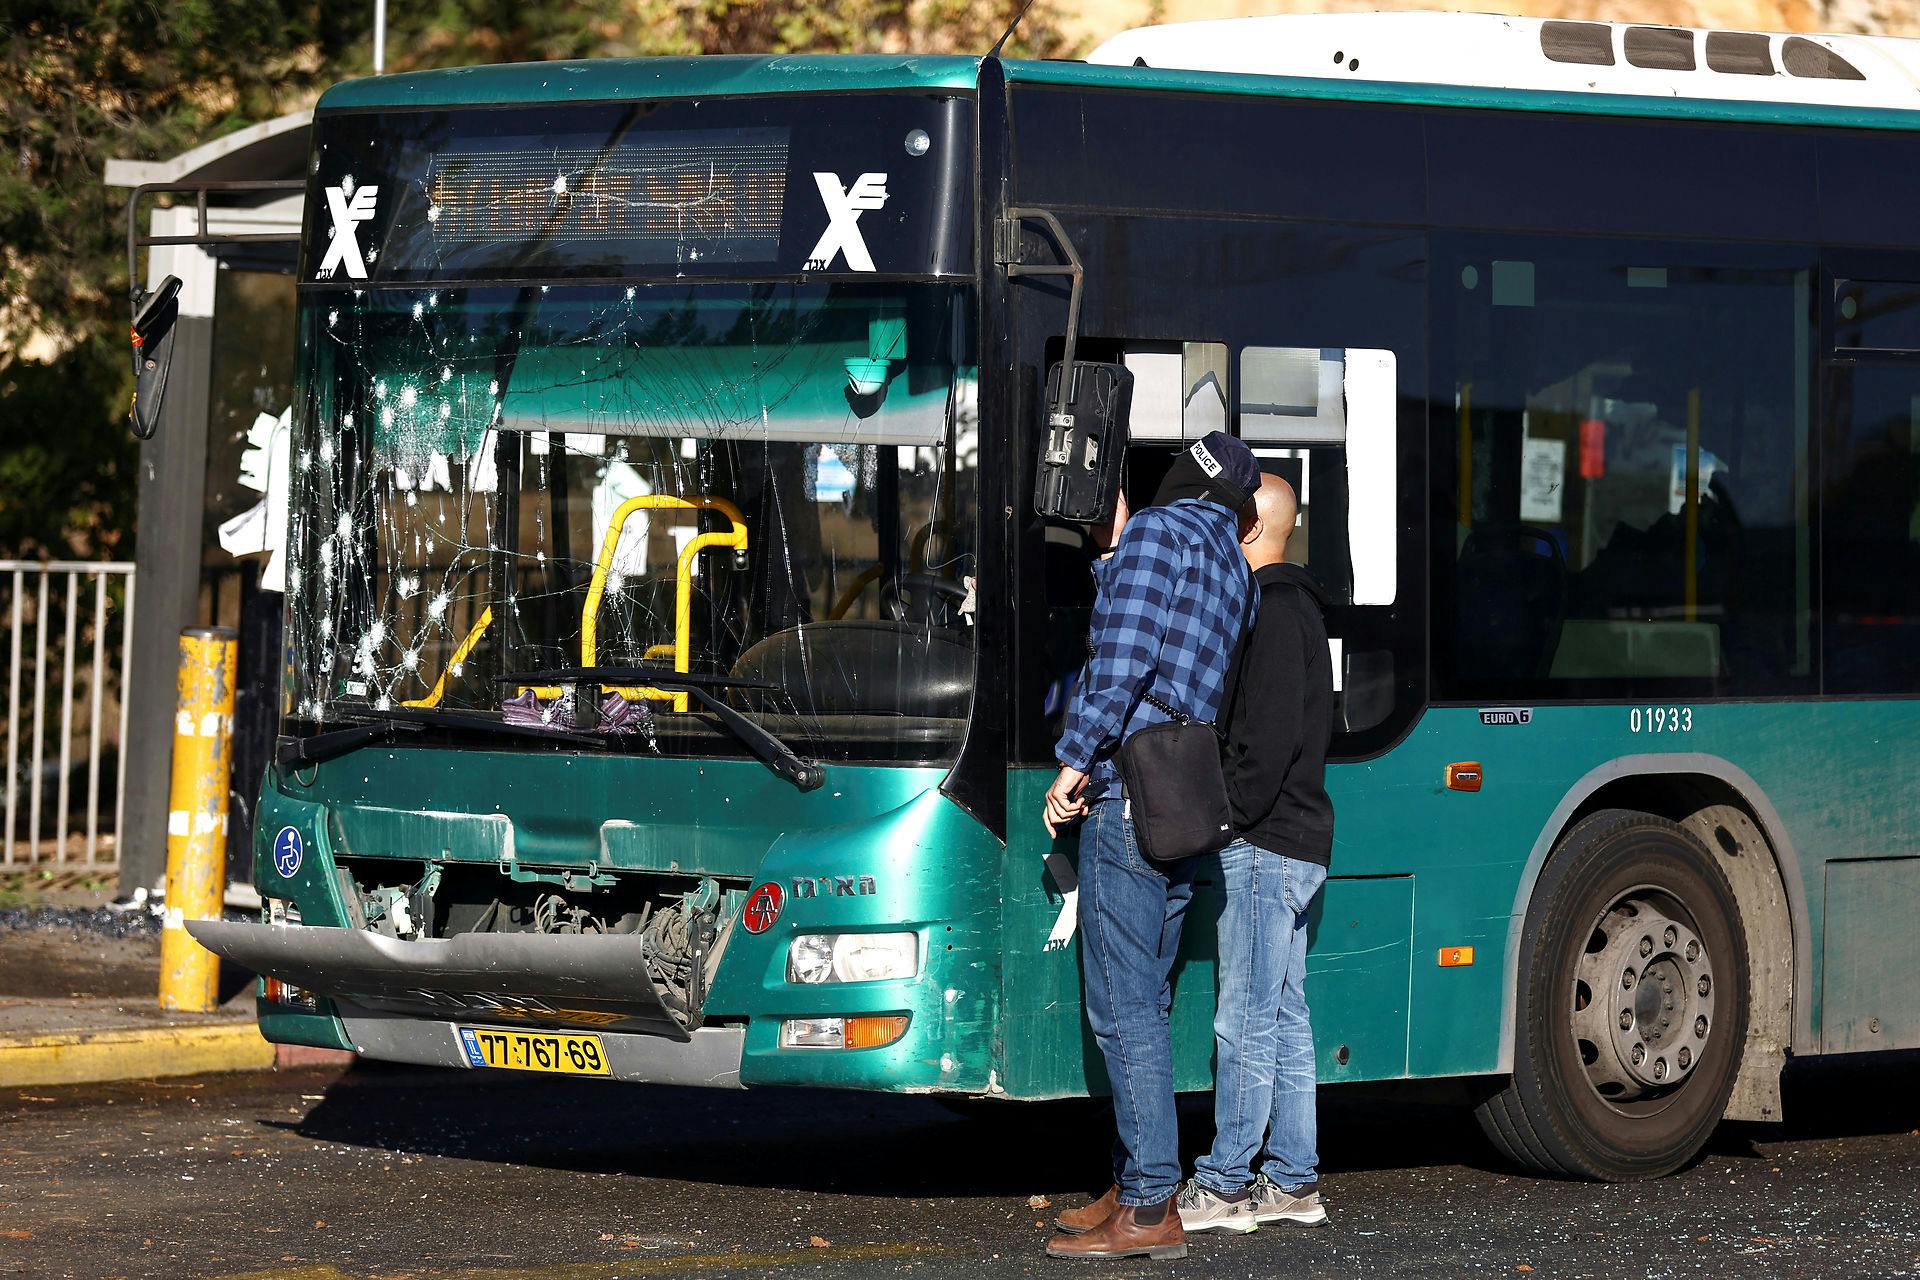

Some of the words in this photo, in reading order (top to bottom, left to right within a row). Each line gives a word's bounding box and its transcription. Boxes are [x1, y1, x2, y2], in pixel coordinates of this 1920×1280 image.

[1194, 444, 1217, 472] POLICE
[1484, 713, 1514, 724] EURO
[1520, 710, 1529, 722] 6
[1630, 708, 1692, 732] 01933
